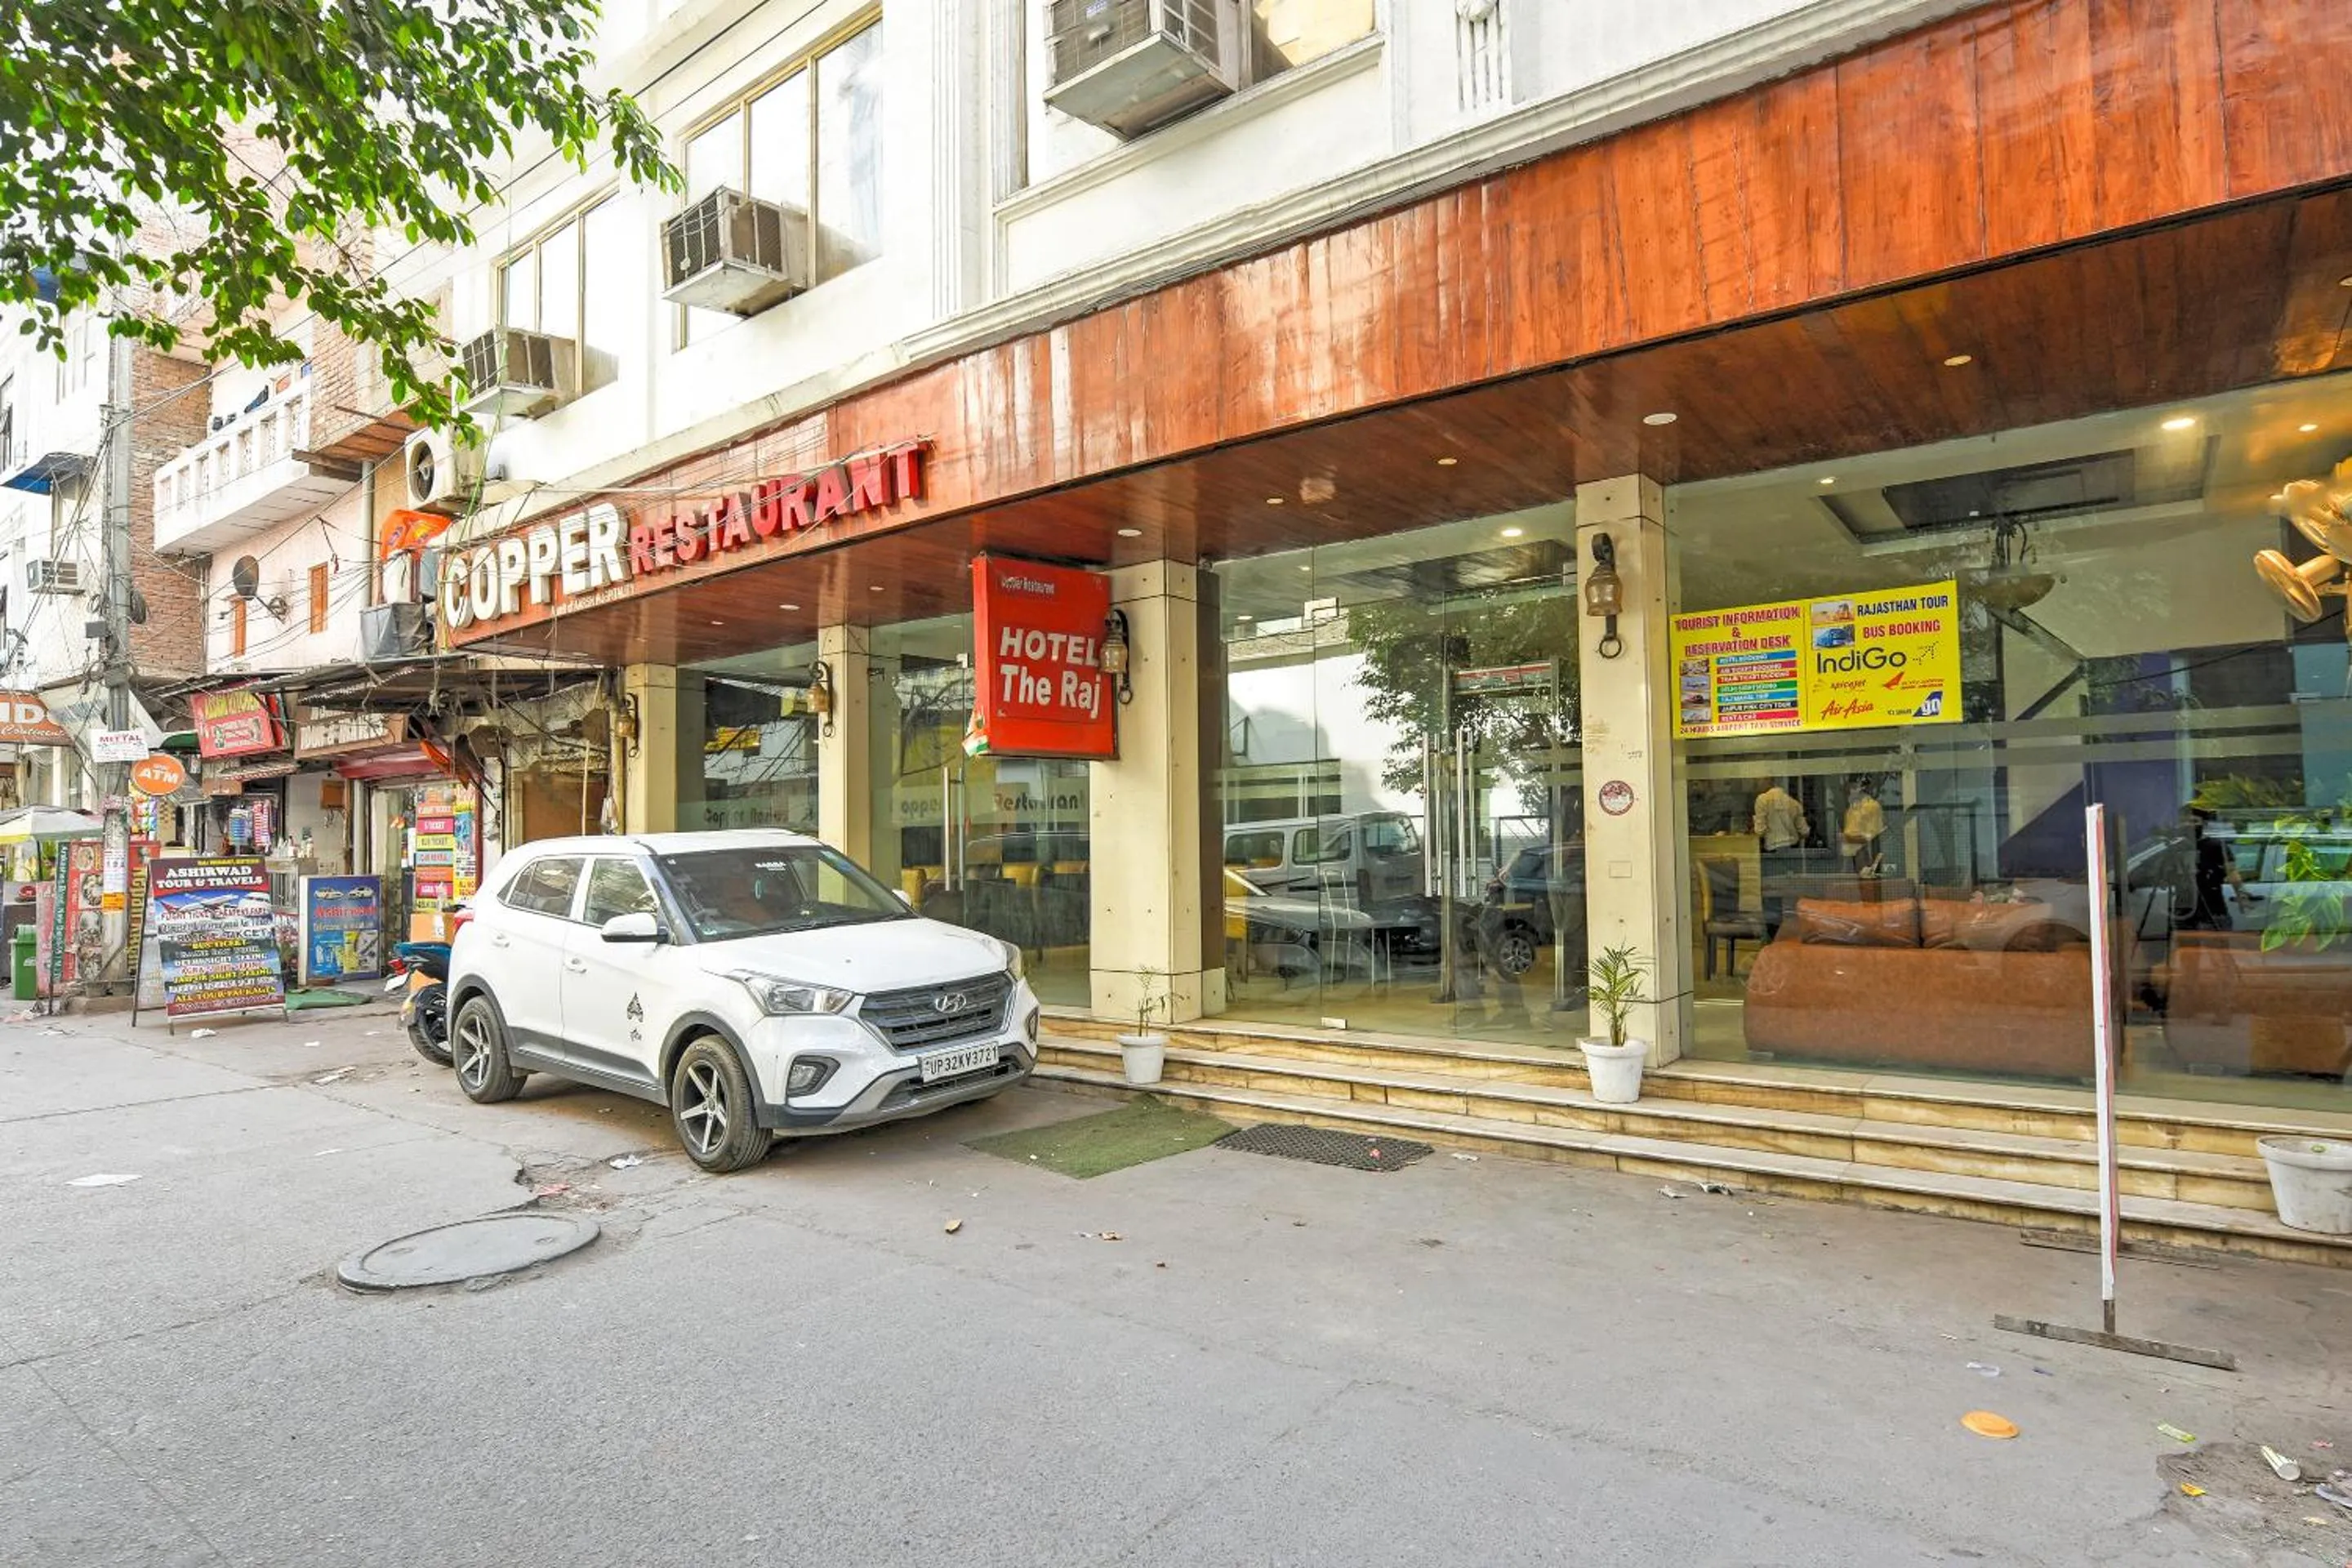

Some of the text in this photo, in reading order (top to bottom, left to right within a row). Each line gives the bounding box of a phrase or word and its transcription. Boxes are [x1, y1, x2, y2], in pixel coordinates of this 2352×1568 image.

[445, 442, 921, 629] COPPER RESTAURANT
[1857, 595, 1948, 617] RAJASTHAN TOUR
[1675, 606, 1801, 632] TOURIST INFORMATION
[1863, 619, 1940, 639] BUS BOOKING
[1731, 626, 1741, 638] &
[1000, 626, 1100, 667] HOTEL
[1685, 635, 1791, 657] RESERVATION DESK
[1817, 647, 1907, 674] IndiGo
[1000, 664, 1101, 719] The Raj
[137, 768, 179, 784] ATM
[157, 875, 263, 889] TOUR & TRAVELS
[166, 866, 252, 879] ASHIRWAD
